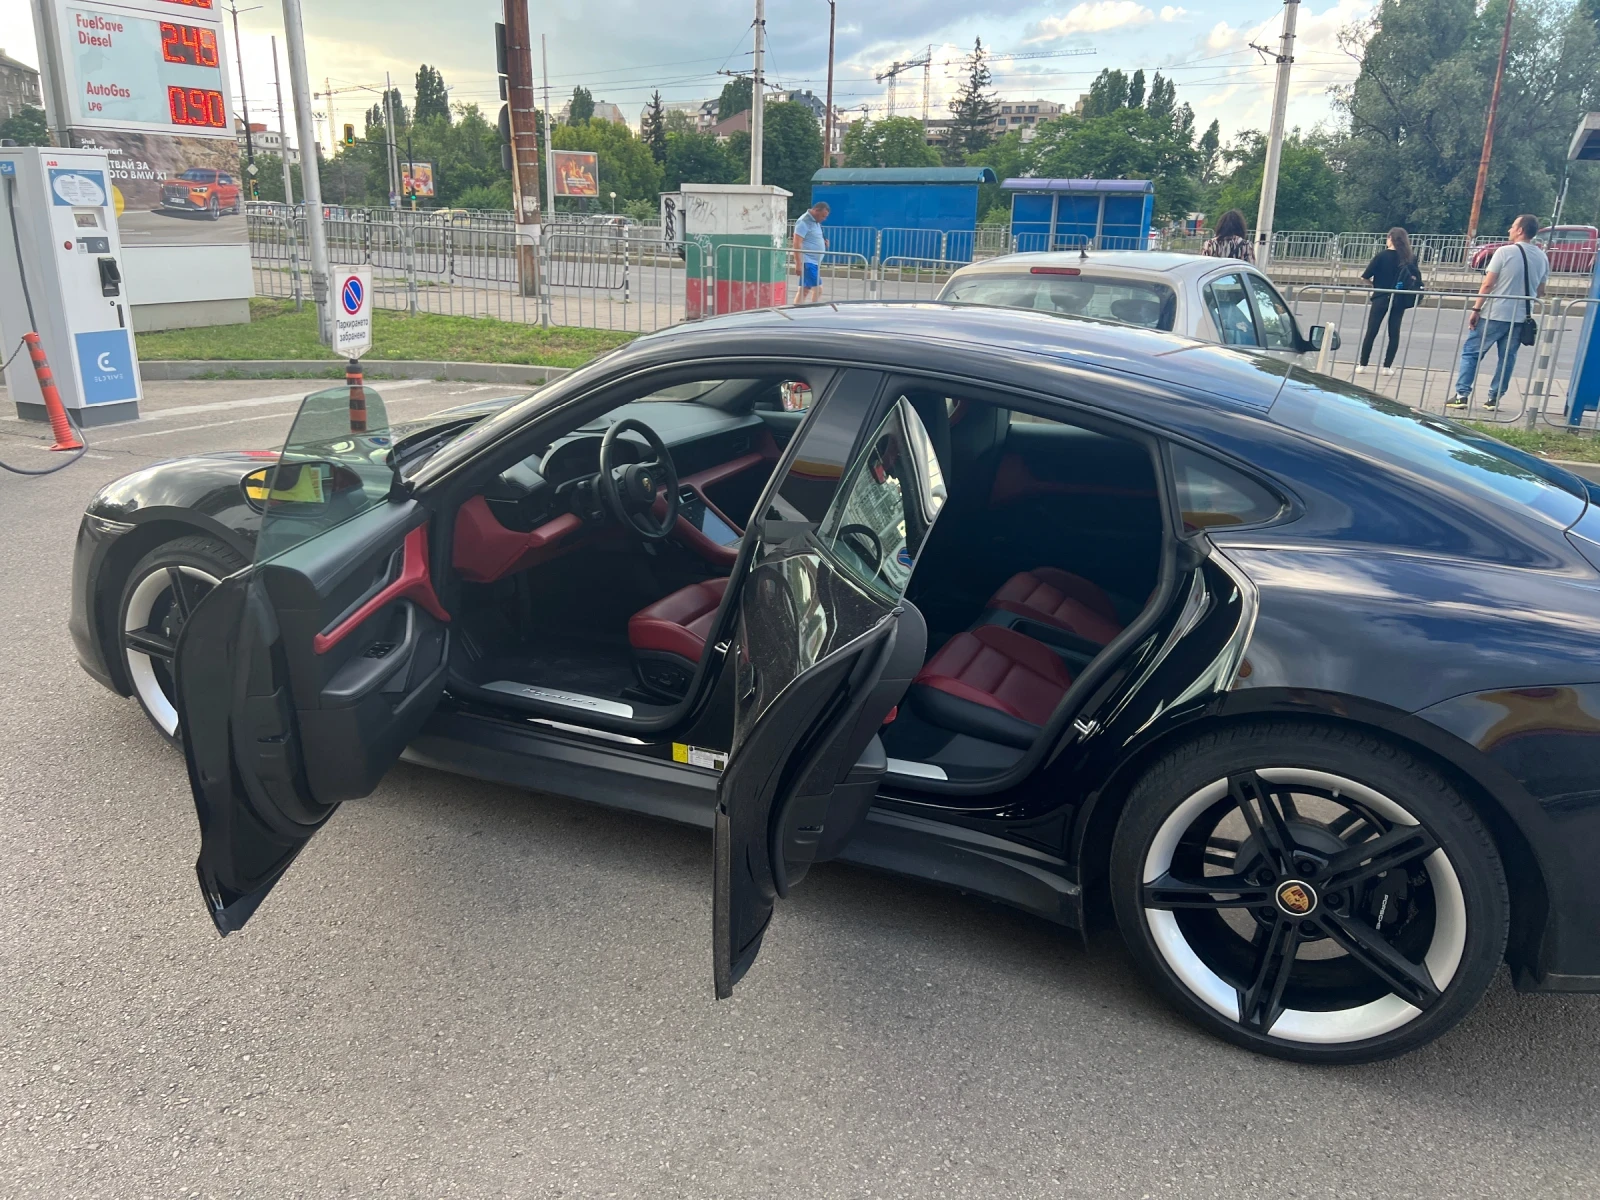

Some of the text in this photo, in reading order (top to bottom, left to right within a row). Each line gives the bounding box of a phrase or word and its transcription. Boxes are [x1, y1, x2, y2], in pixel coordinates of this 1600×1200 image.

[76, 13, 123, 33] FuelSave
[78, 30, 112, 48] Diesel
[160, 22, 219, 67] 2.49
[86, 81, 131, 98] AutoGas
[87, 101, 103, 112] LPG
[168, 86, 226, 128] 0.90
[108, 158, 150, 170] ТВАЙ ЗА
[109, 170, 128, 179] ОТО
[131, 171, 154, 180] BMW
[156, 172, 167, 180] X1
